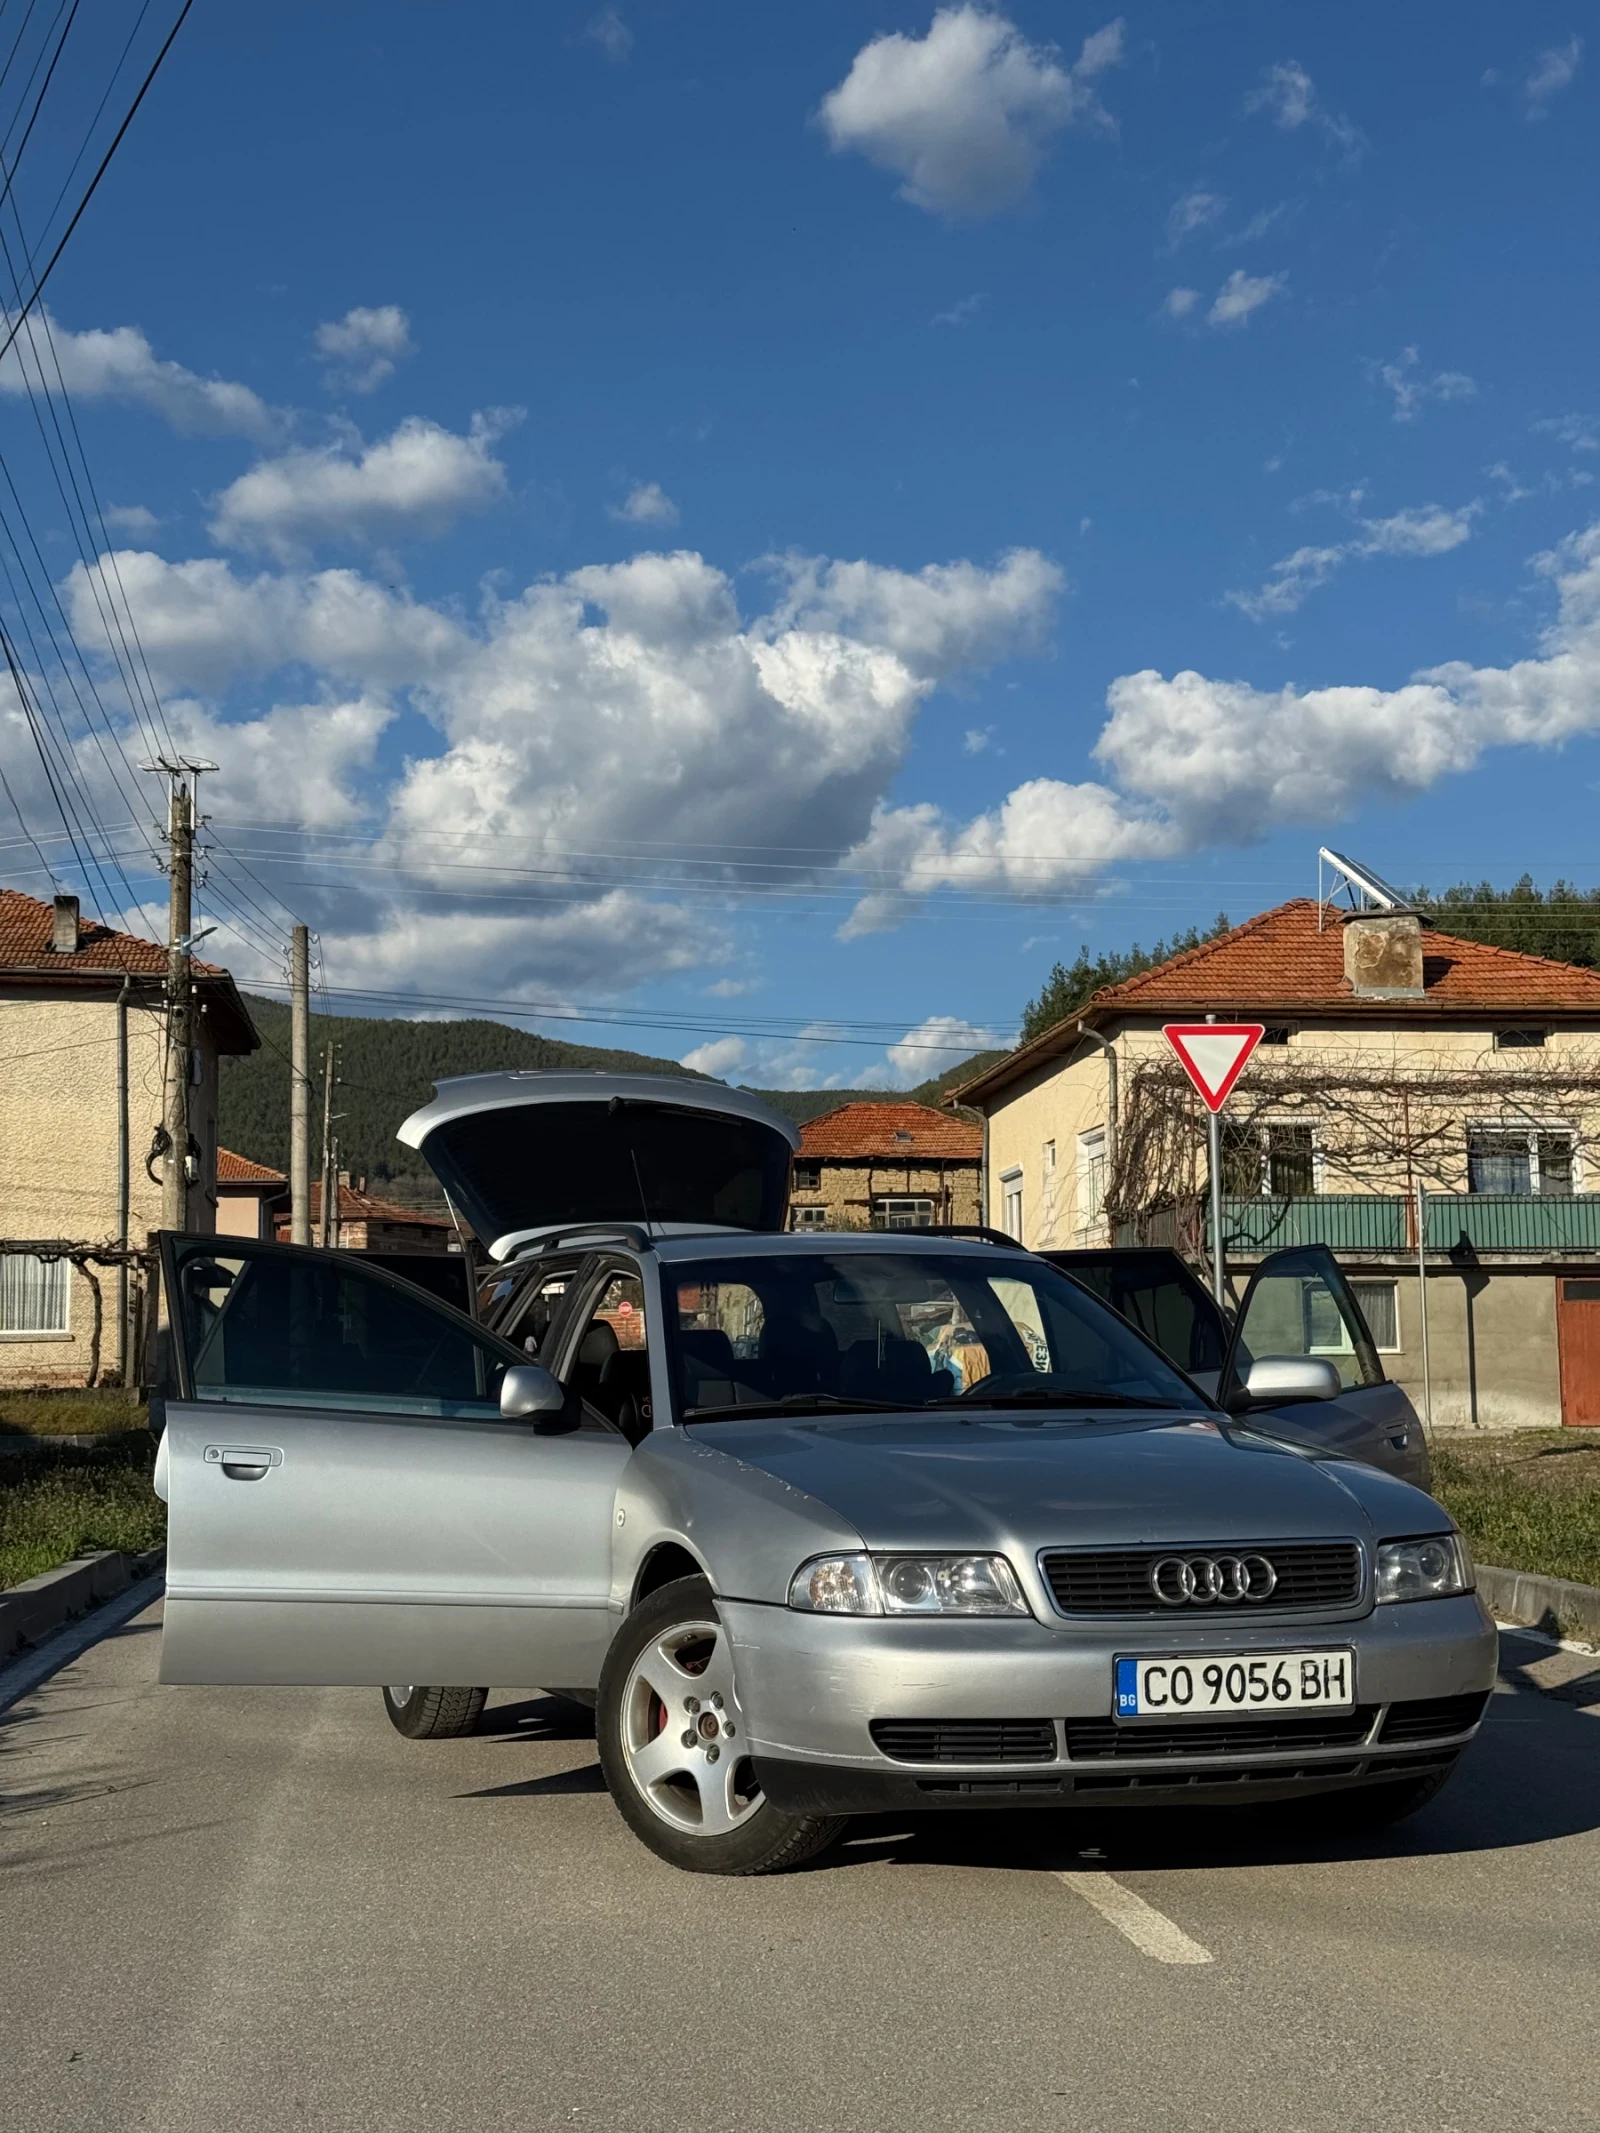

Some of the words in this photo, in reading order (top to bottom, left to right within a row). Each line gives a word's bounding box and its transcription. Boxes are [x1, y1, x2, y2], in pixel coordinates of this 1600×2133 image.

[1144, 1666, 1193, 1707] CO
[1202, 1661, 1292, 1705] 9056
[1300, 1658, 1346, 1701] BH
[1119, 1694, 1136, 1707] BG
